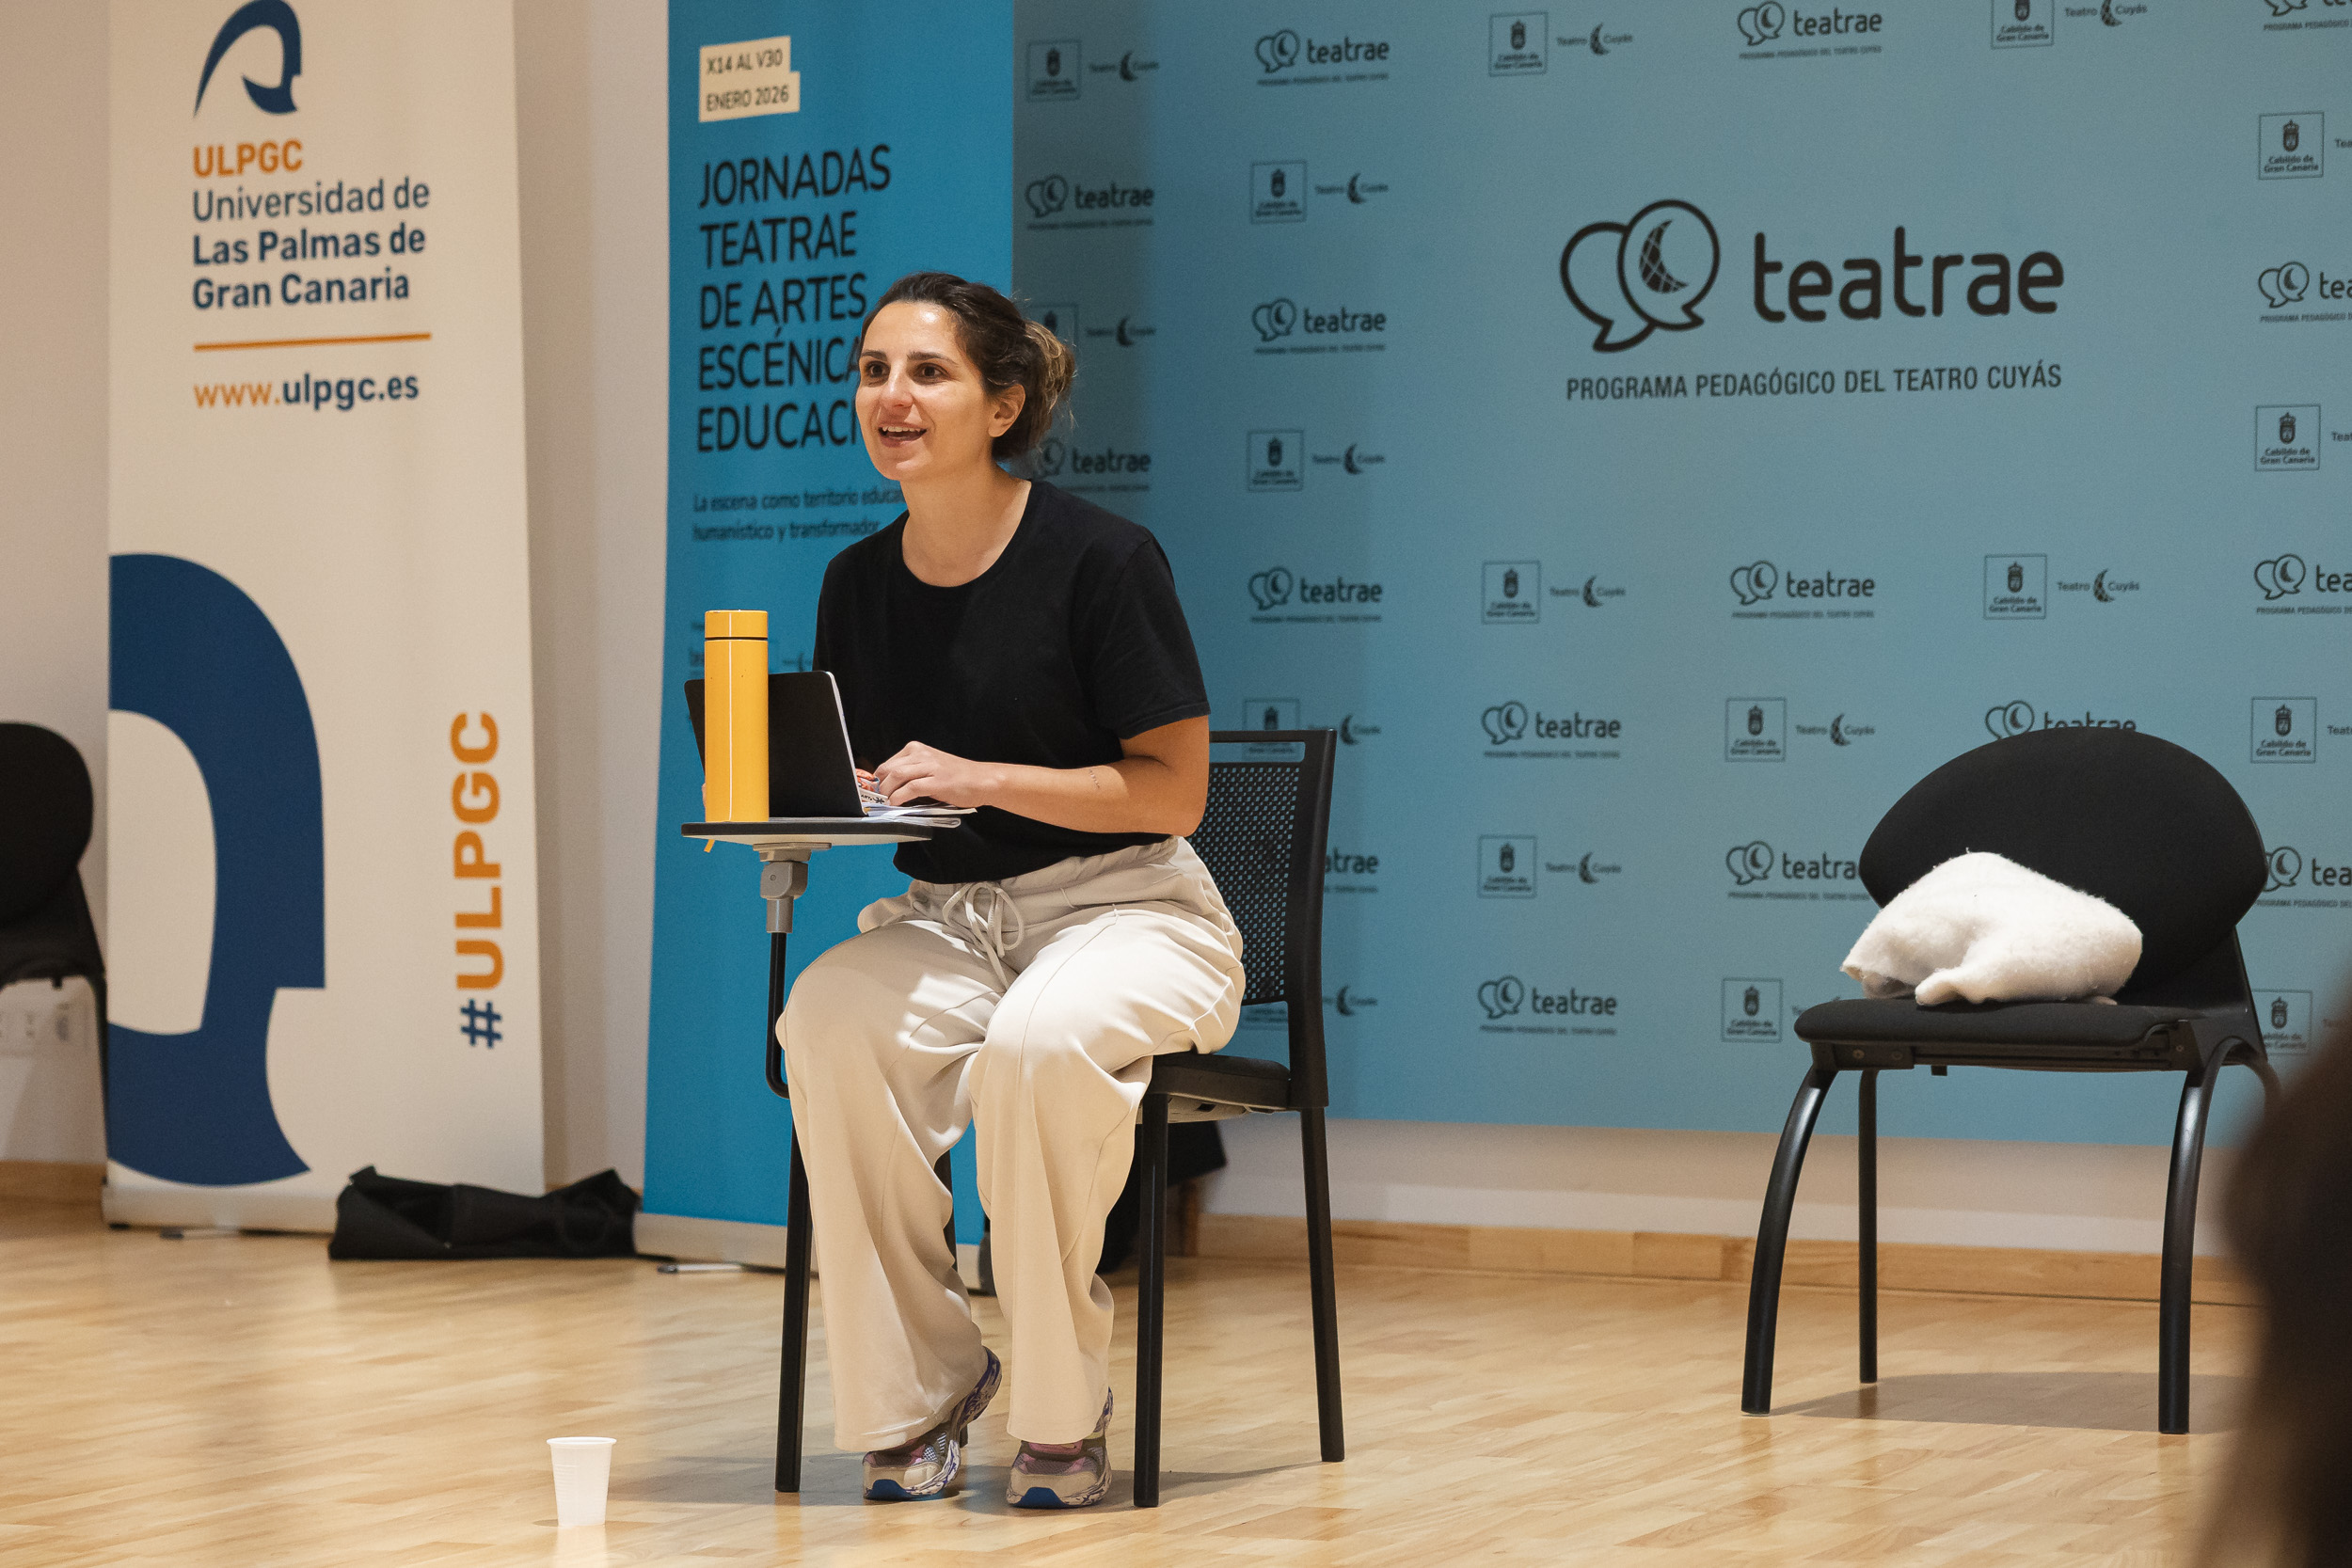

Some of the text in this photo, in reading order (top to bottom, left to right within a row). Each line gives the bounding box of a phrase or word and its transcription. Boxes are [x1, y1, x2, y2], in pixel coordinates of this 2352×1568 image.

[1794, 8, 1883, 36] teatrae
[707, 49, 783, 74] X14 AL V30
[1307, 37, 1390, 64] teatrae
[707, 85, 789, 112] ENERO 2026
[194, 139, 303, 178] ULPGC
[699, 144, 891, 209] JORNADAS
[193, 176, 430, 222] Universidad de
[1074, 182, 1154, 209] teatrae
[193, 222, 426, 265] Las Palmas de
[700, 211, 857, 268] TEATRAE
[193, 267, 410, 309] Gran Canaria
[1755, 226, 2064, 322] teatrae
[700, 273, 867, 330] DE ARTES
[1304, 307, 1387, 333] teatrae
[194, 373, 420, 411] www.ulpgc.es
[1567, 359, 2062, 401] PROGRAMA PEDAGÓGICO DEL TEATRO CUYÁS
[1072, 448, 1152, 474] teatrae
[1300, 576, 1382, 603] teatrae
[1787, 570, 1875, 597] teatrae
[1535, 711, 1621, 738] teatrae
[1325, 847, 1378, 873] atrae
[1783, 851, 1858, 879] teatra
[450, 711, 504, 1049] #ULPGC
[1533, 987, 1617, 1015] teatrae
